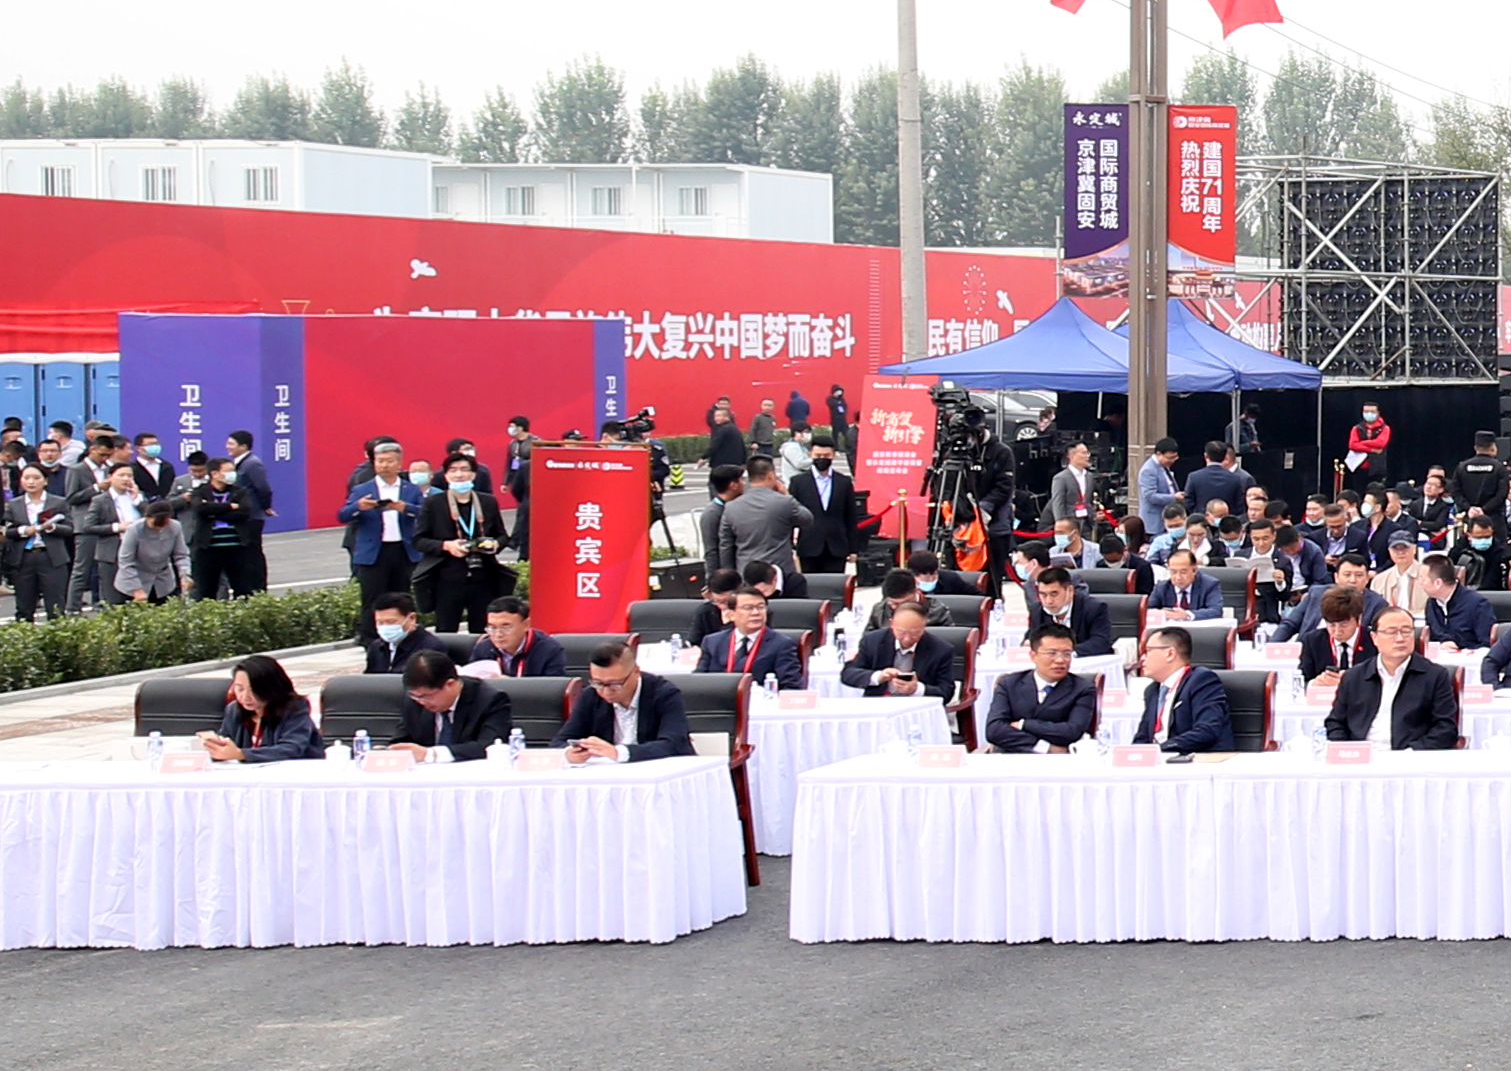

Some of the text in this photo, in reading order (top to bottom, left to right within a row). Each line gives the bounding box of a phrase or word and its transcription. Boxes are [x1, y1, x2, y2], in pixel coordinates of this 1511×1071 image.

[1077, 138, 1096, 229] 京津冀固安
[1099, 139, 1119, 229] 国际商贸城
[1181, 140, 1200, 213] 热烈庆祝
[1202, 141, 1223, 233] 建国71周年
[179, 384, 202, 462] 卫生间
[274, 385, 291, 462] 卫生间
[575, 502, 603, 598] 贵宾区
